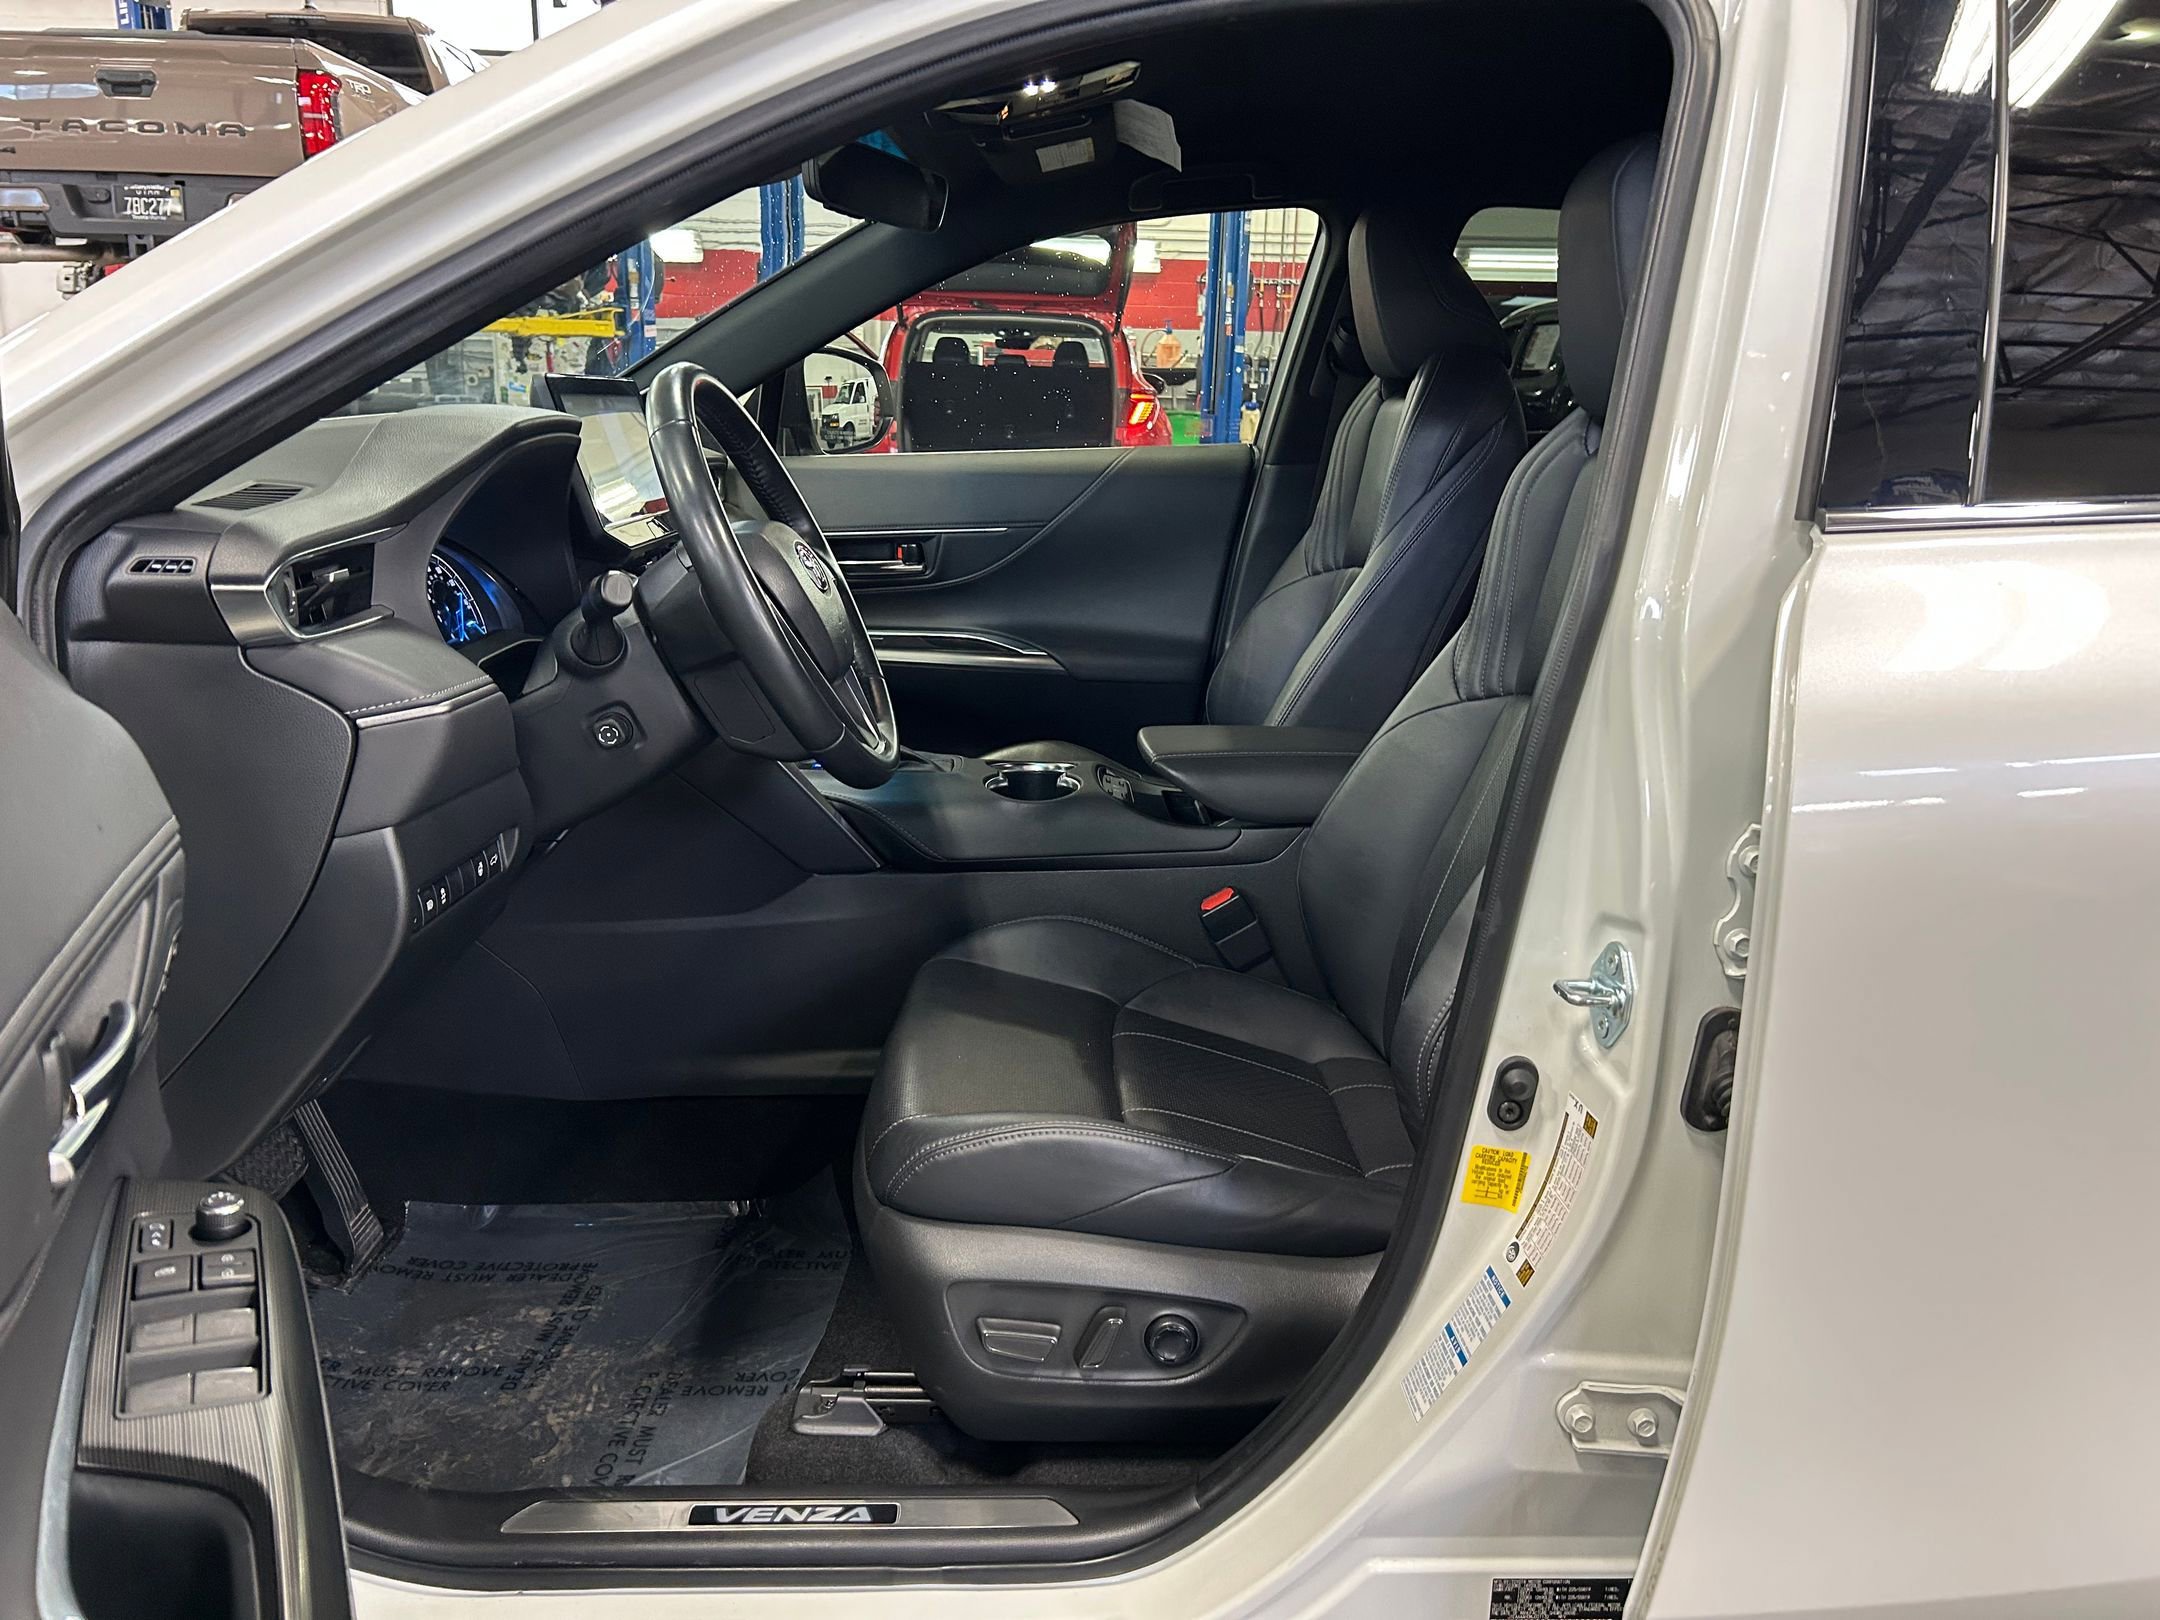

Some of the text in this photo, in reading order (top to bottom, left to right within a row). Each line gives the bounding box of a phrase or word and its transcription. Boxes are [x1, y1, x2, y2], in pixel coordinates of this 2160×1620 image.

[345, 78, 372, 95] TRD
[20, 117, 248, 138] TACOMA
[406, 1256, 581, 1274] PROTECTIVE COVER
[445, 1270, 496, 1283] MUST
[506, 1271, 574, 1284] DEALER
[1490, 1273, 1506, 1298] NOTICE
[422, 1365, 506, 1378] REMOVE
[382, 1379, 451, 1392] COVER
[680, 1384, 768, 1398] REMOVE
[625, 1425, 656, 1466] MUST
[715, 1506, 872, 1523] VENZA
